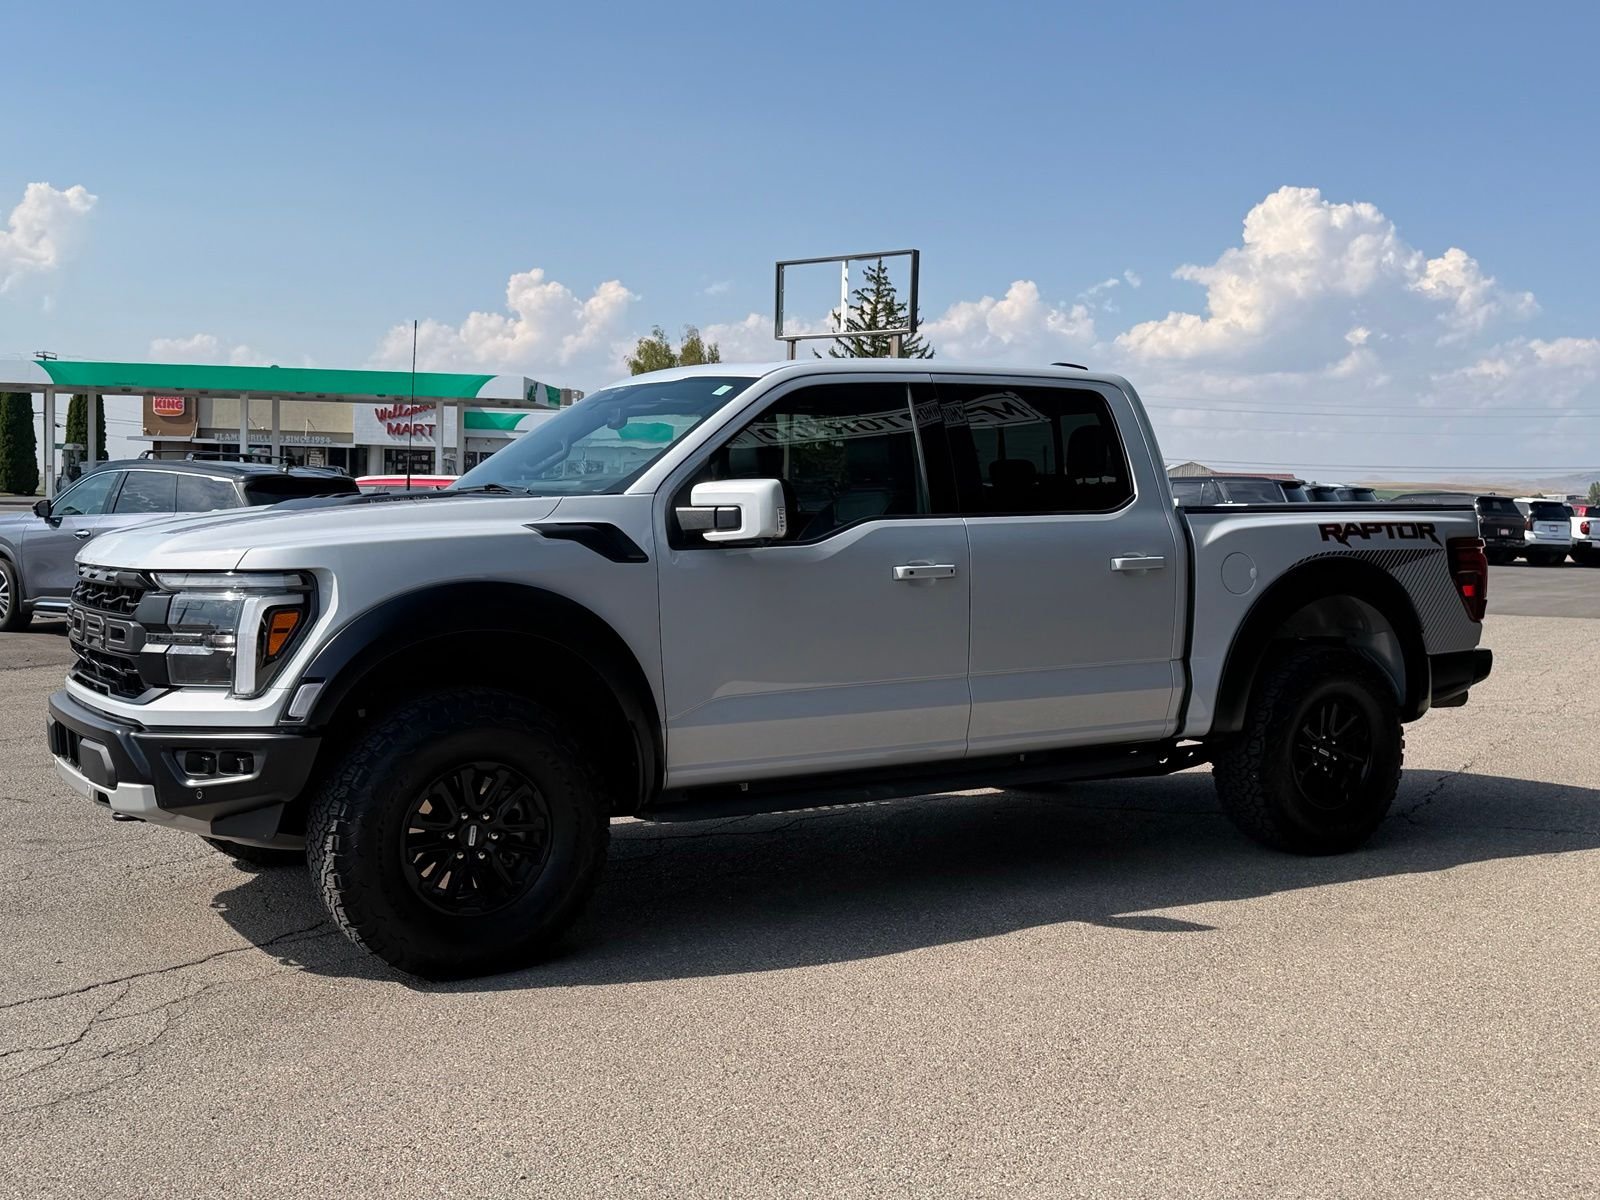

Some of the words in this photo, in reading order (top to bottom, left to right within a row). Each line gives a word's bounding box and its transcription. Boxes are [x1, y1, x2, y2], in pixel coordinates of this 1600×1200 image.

[154, 399, 184, 409] KING
[387, 422, 436, 436] MART
[286, 435, 310, 443] SINCE
[311, 436, 331, 444] 1954
[1318, 522, 1443, 548] RAPTOR
